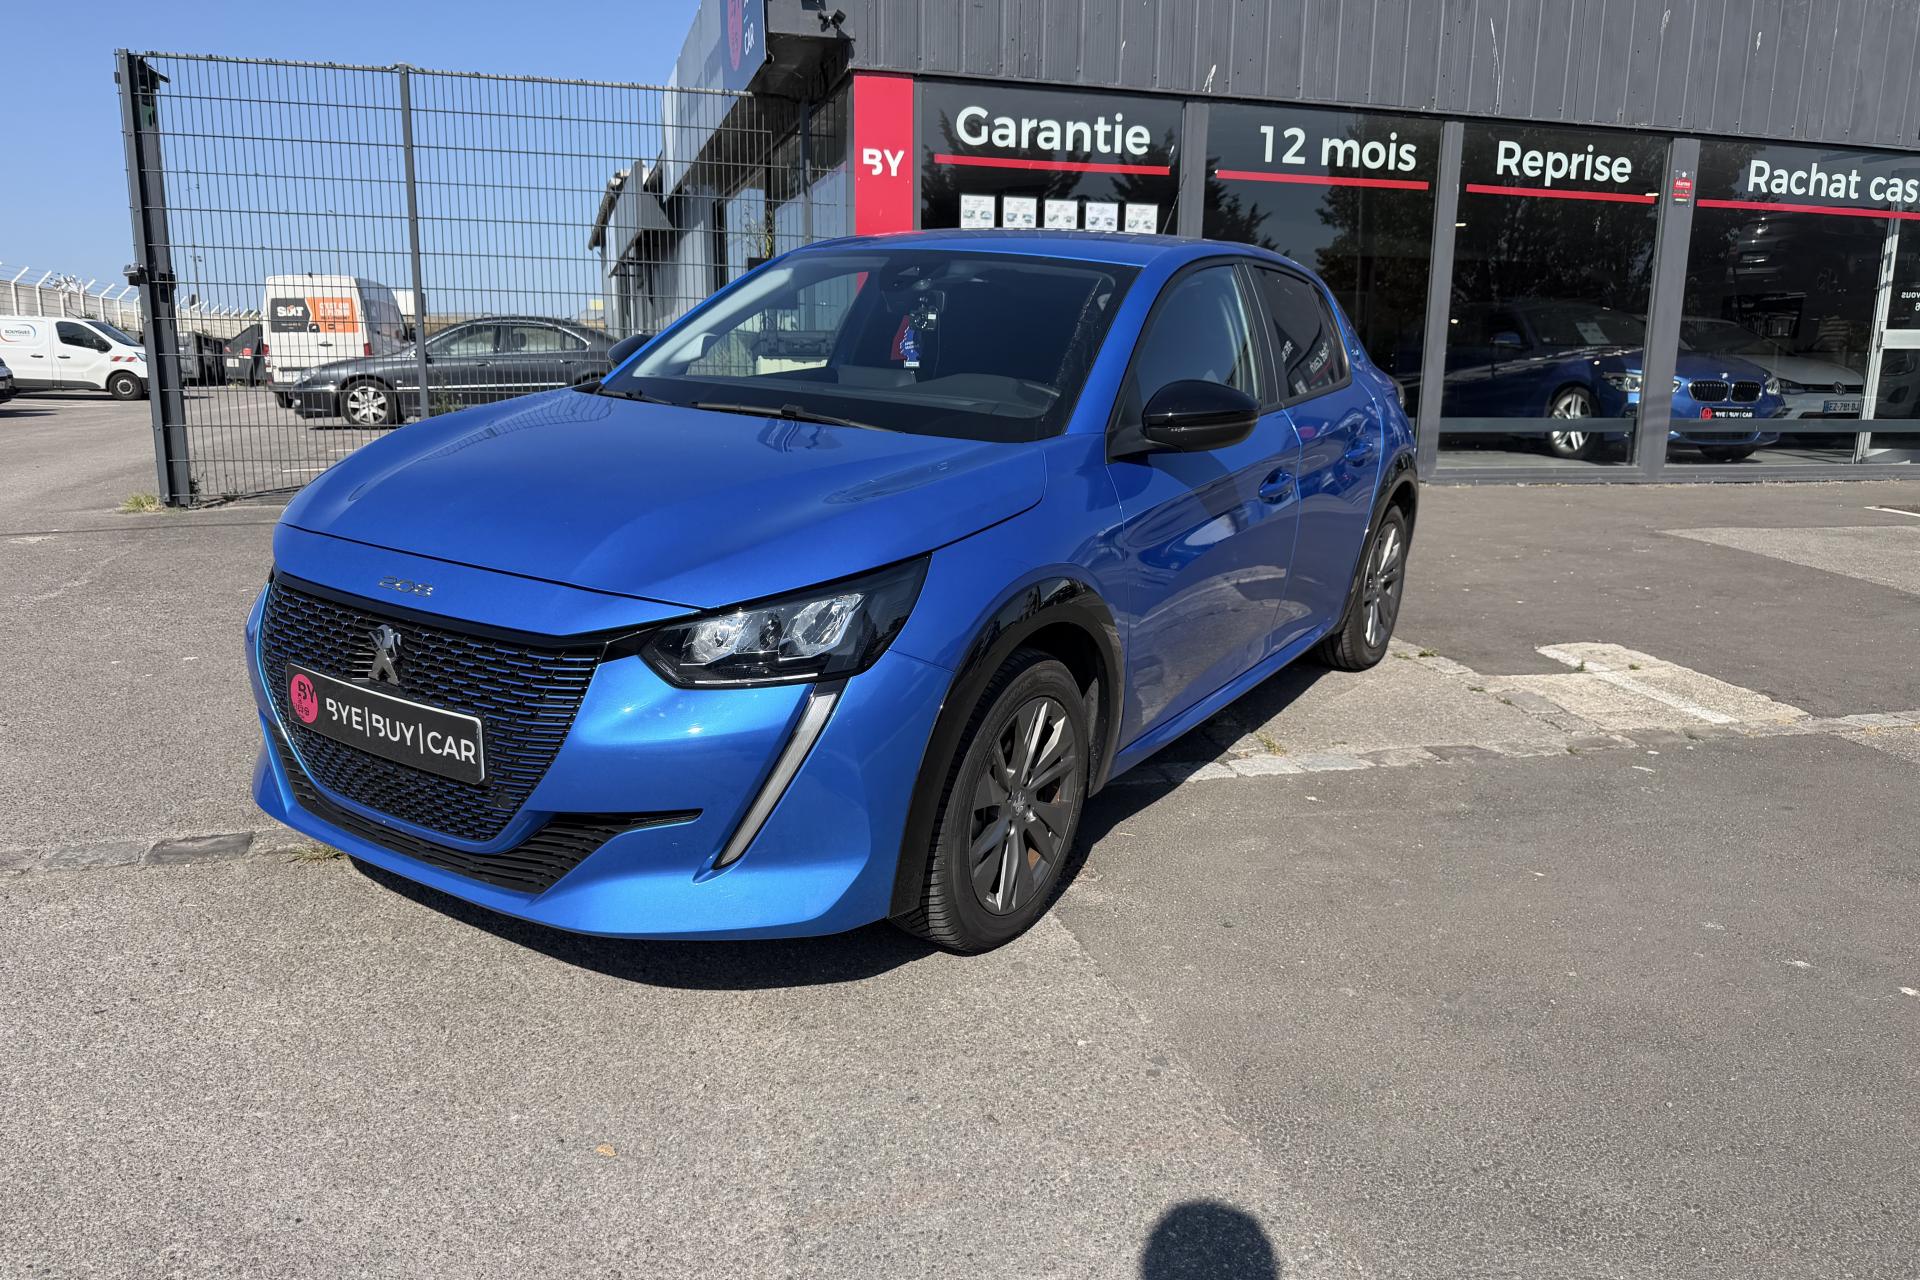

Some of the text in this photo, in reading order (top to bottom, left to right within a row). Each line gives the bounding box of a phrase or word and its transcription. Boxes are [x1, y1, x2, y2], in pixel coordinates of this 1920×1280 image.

[956, 106, 1151, 156] Garantie
[1260, 125, 1417, 172] 12 mois
[863, 148, 905, 177] BY
[1496, 140, 1632, 187] Reprise
[1747, 159, 1920, 203] Rachat cas
